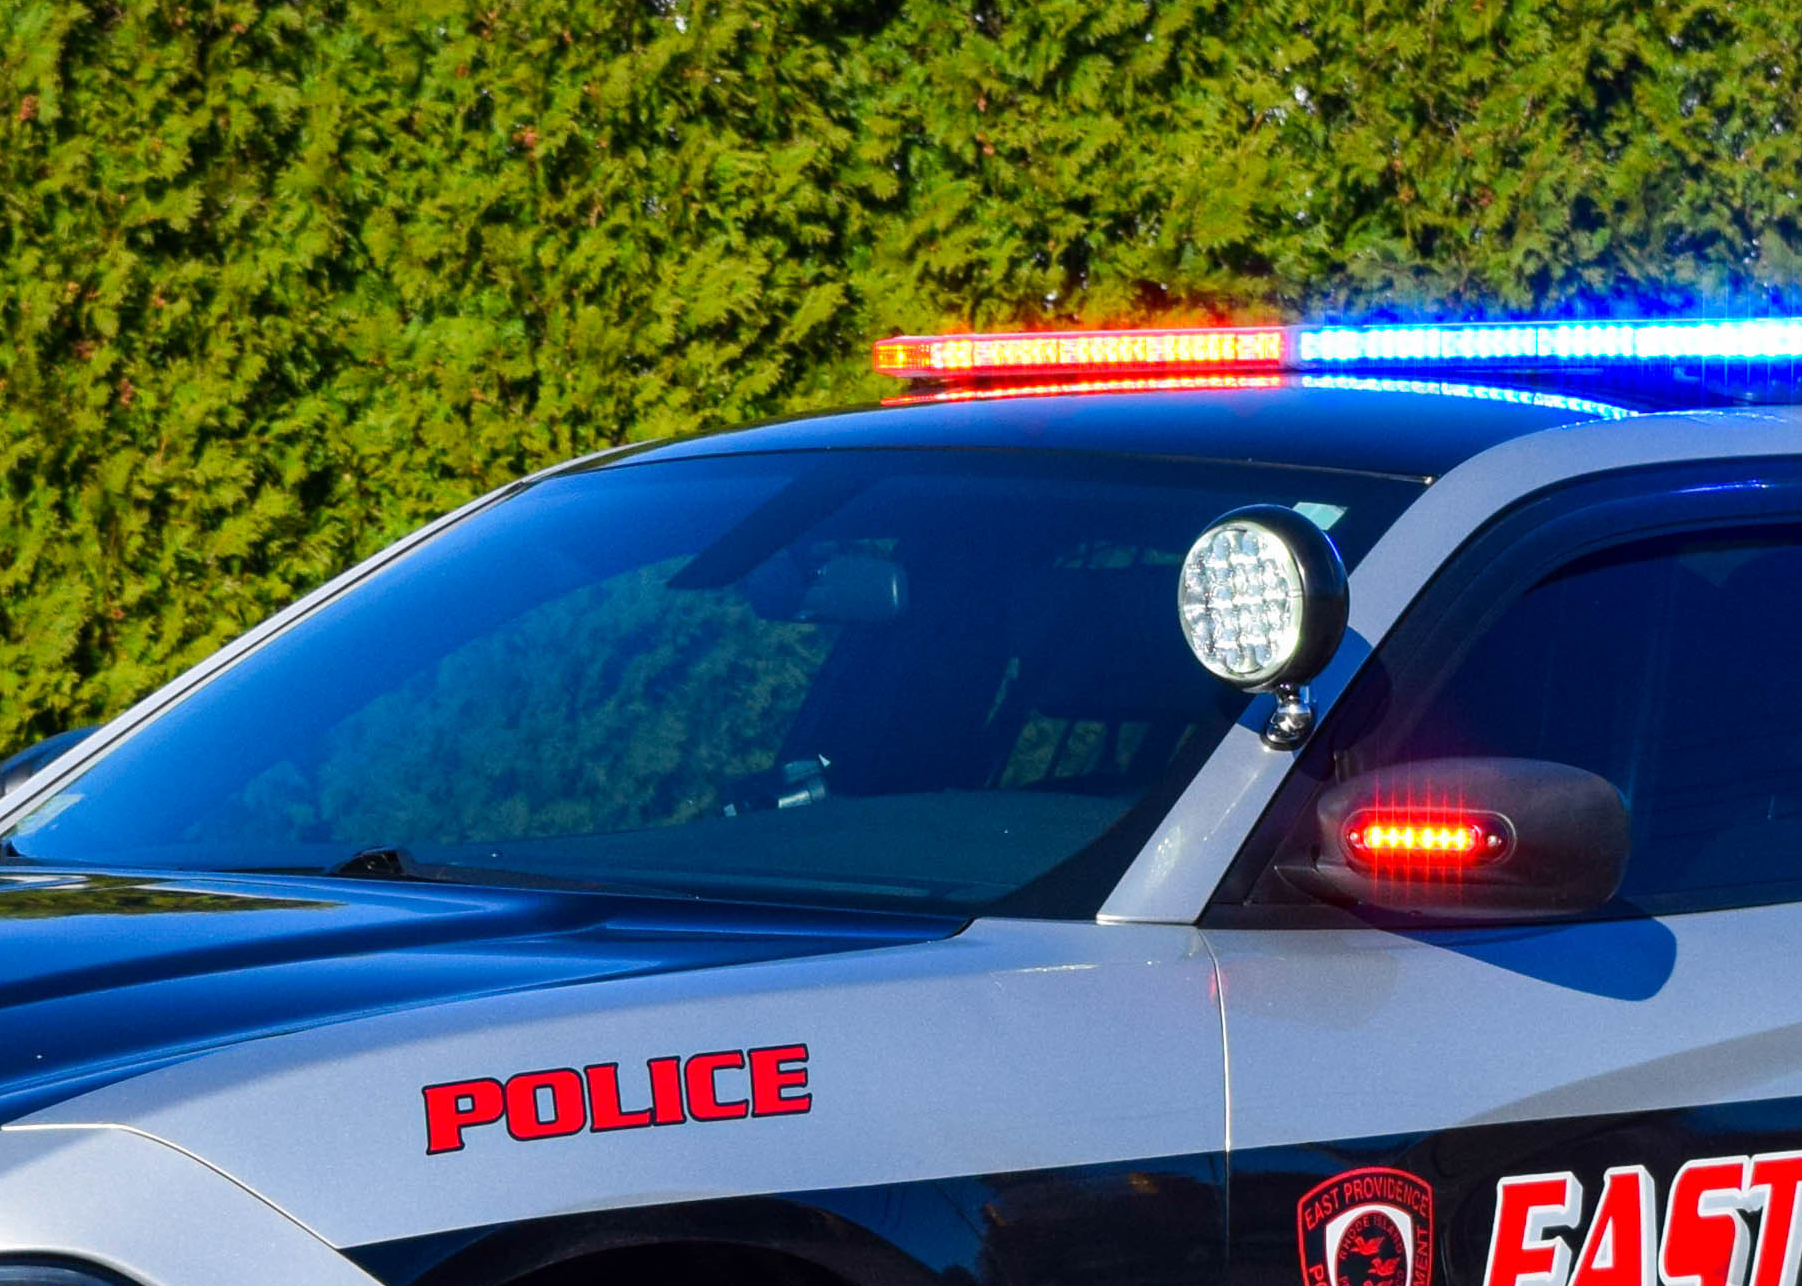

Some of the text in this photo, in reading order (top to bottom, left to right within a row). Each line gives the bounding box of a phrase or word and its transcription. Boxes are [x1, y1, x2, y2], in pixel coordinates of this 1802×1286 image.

[421, 1043, 812, 1155] POLICE
[1305, 1176, 1429, 1231] EAST PROVIDENCE
